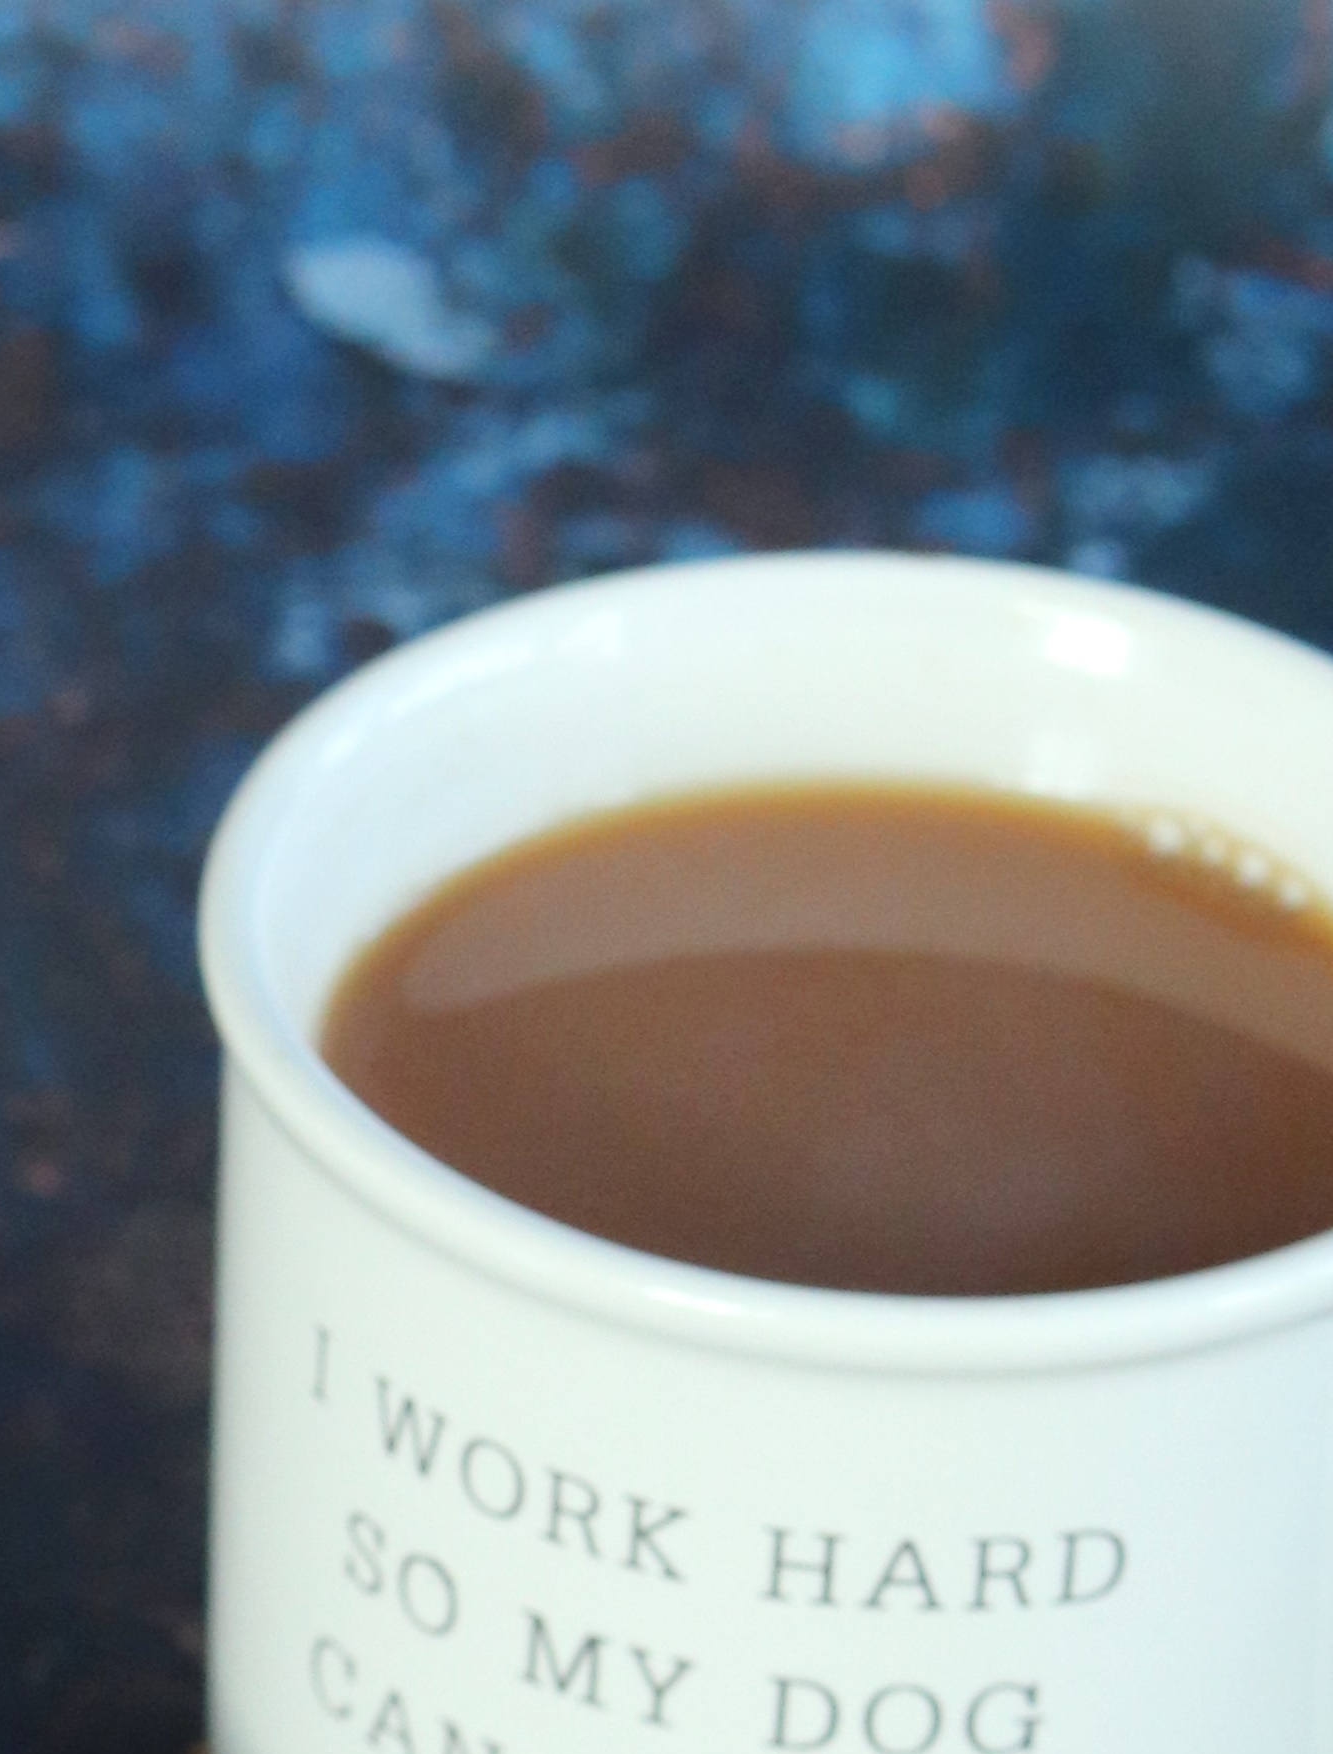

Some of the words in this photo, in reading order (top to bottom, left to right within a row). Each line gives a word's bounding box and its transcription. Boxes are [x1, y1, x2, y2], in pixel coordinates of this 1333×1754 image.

[311, 1323, 331, 1403] I
[373, 1372, 689, 1584] WORK
[760, 1525, 1128, 1615] HARD
[343, 1507, 459, 1638] SO
[521, 1605, 697, 1731] MY
